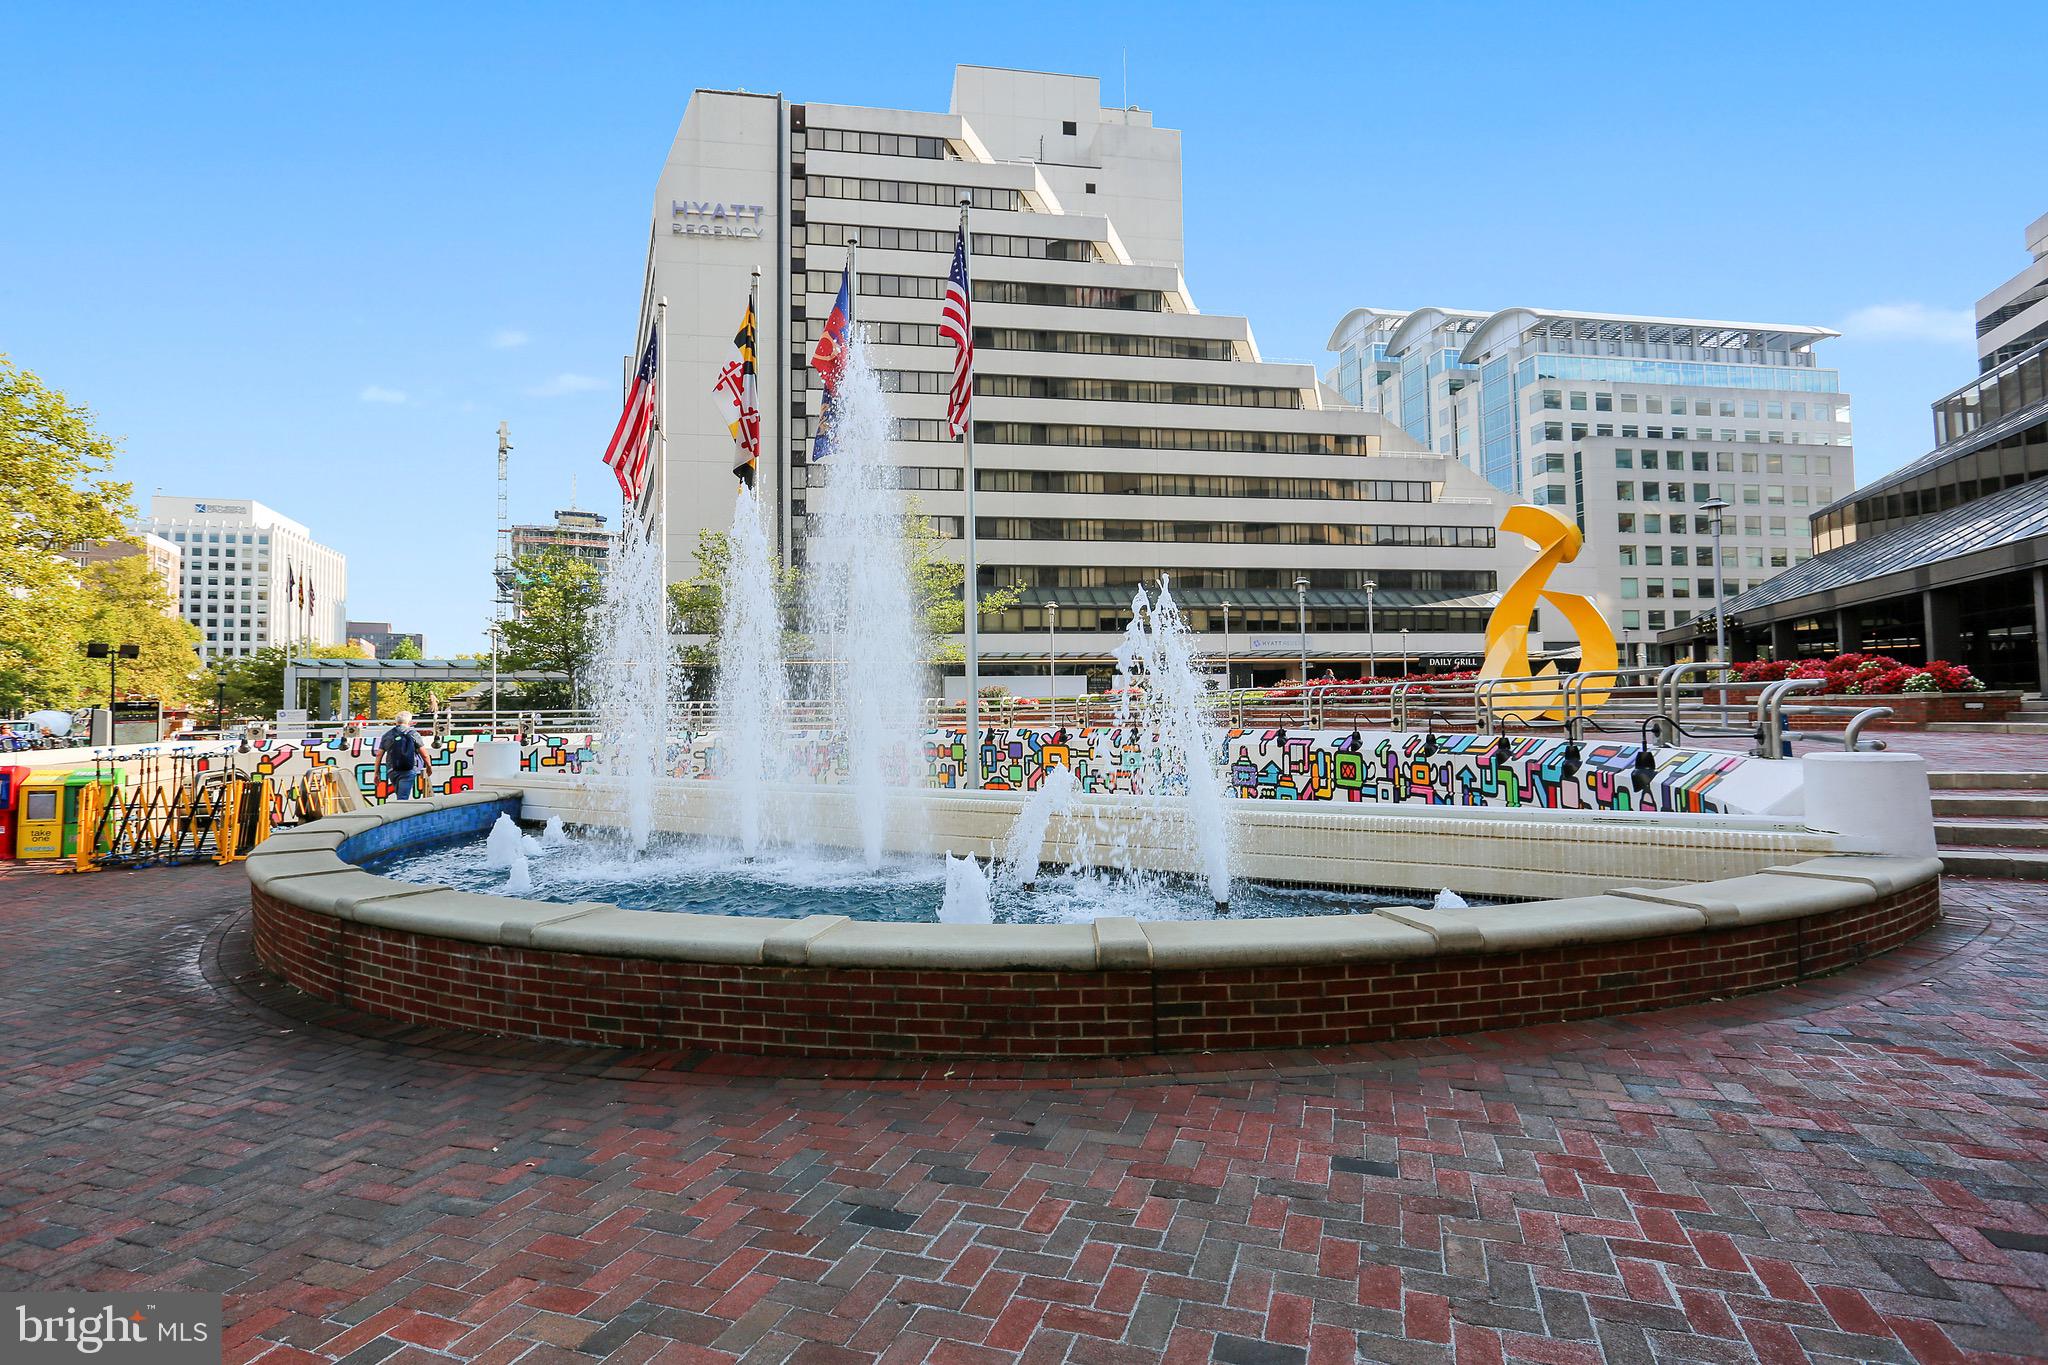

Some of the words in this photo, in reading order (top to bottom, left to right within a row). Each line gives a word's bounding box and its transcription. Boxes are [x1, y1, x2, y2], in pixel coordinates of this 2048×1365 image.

[672, 200, 763, 223] HYATT
[672, 223, 763, 238] REGENCY
[1430, 658, 1452, 666] DAILY
[1454, 658, 1478, 666] GRILL
[31, 829, 51, 837] take
